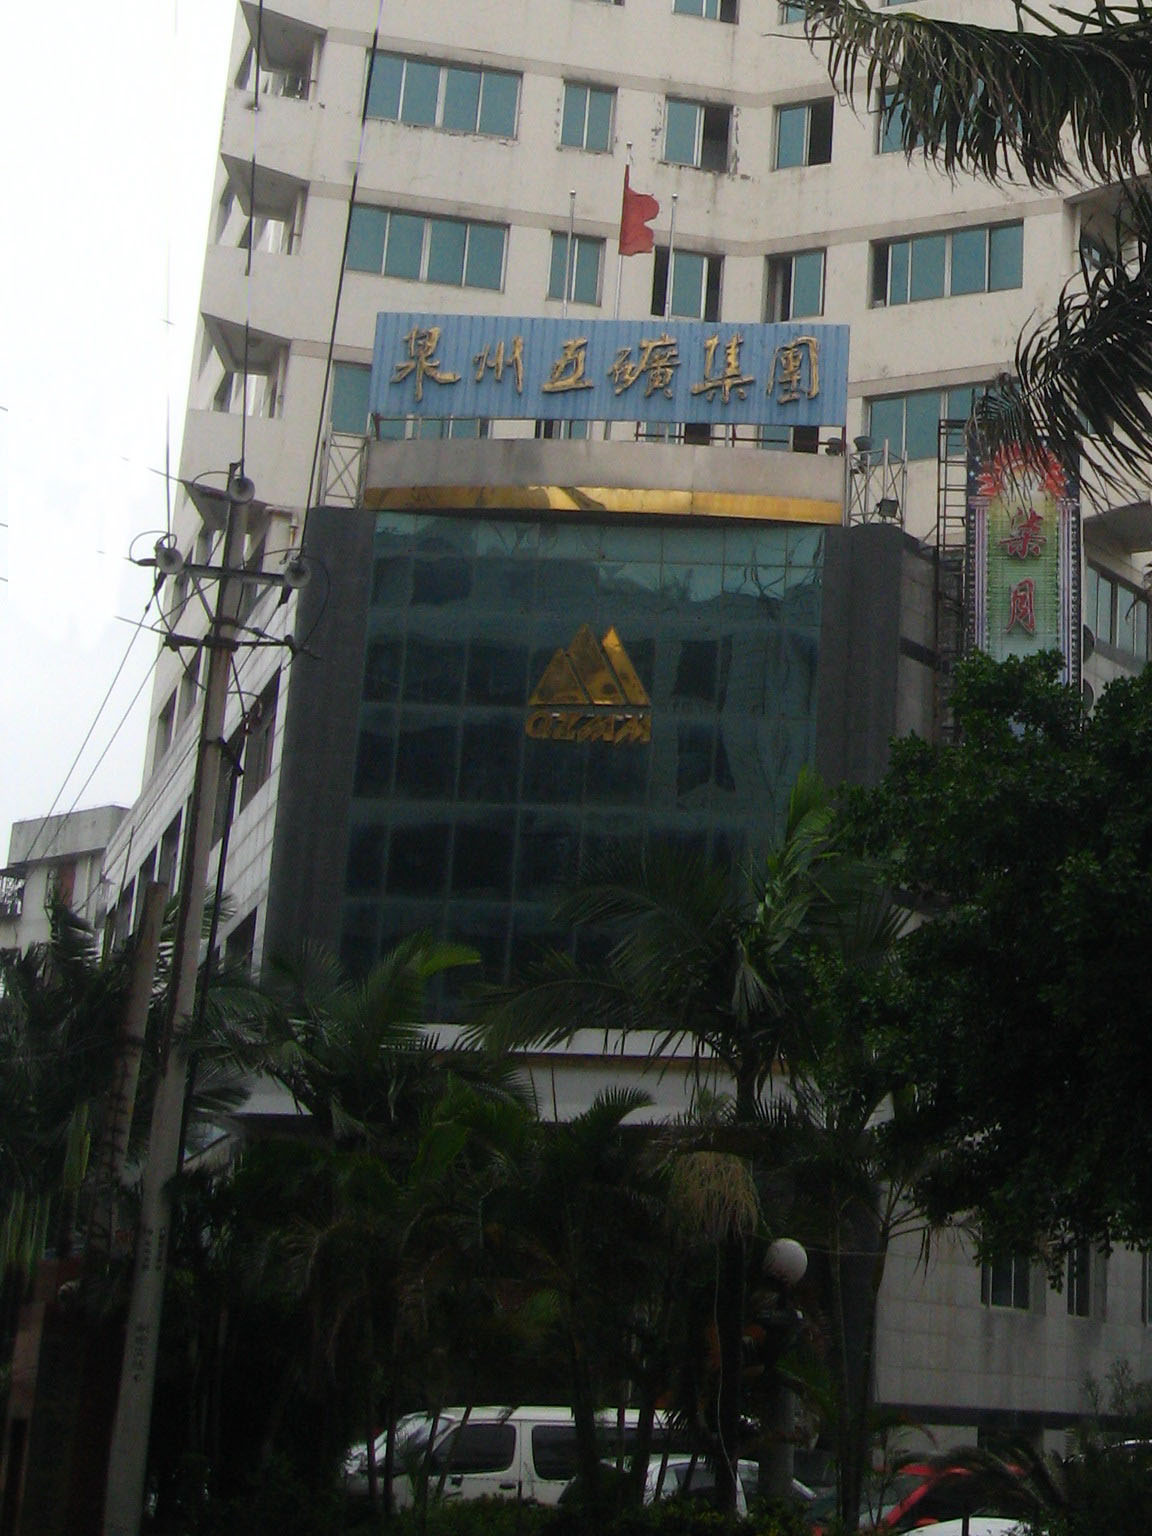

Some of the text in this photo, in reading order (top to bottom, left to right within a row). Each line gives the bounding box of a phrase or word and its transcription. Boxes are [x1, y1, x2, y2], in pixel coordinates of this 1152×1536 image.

[390, 324, 821, 405] 泉州五礦集團
